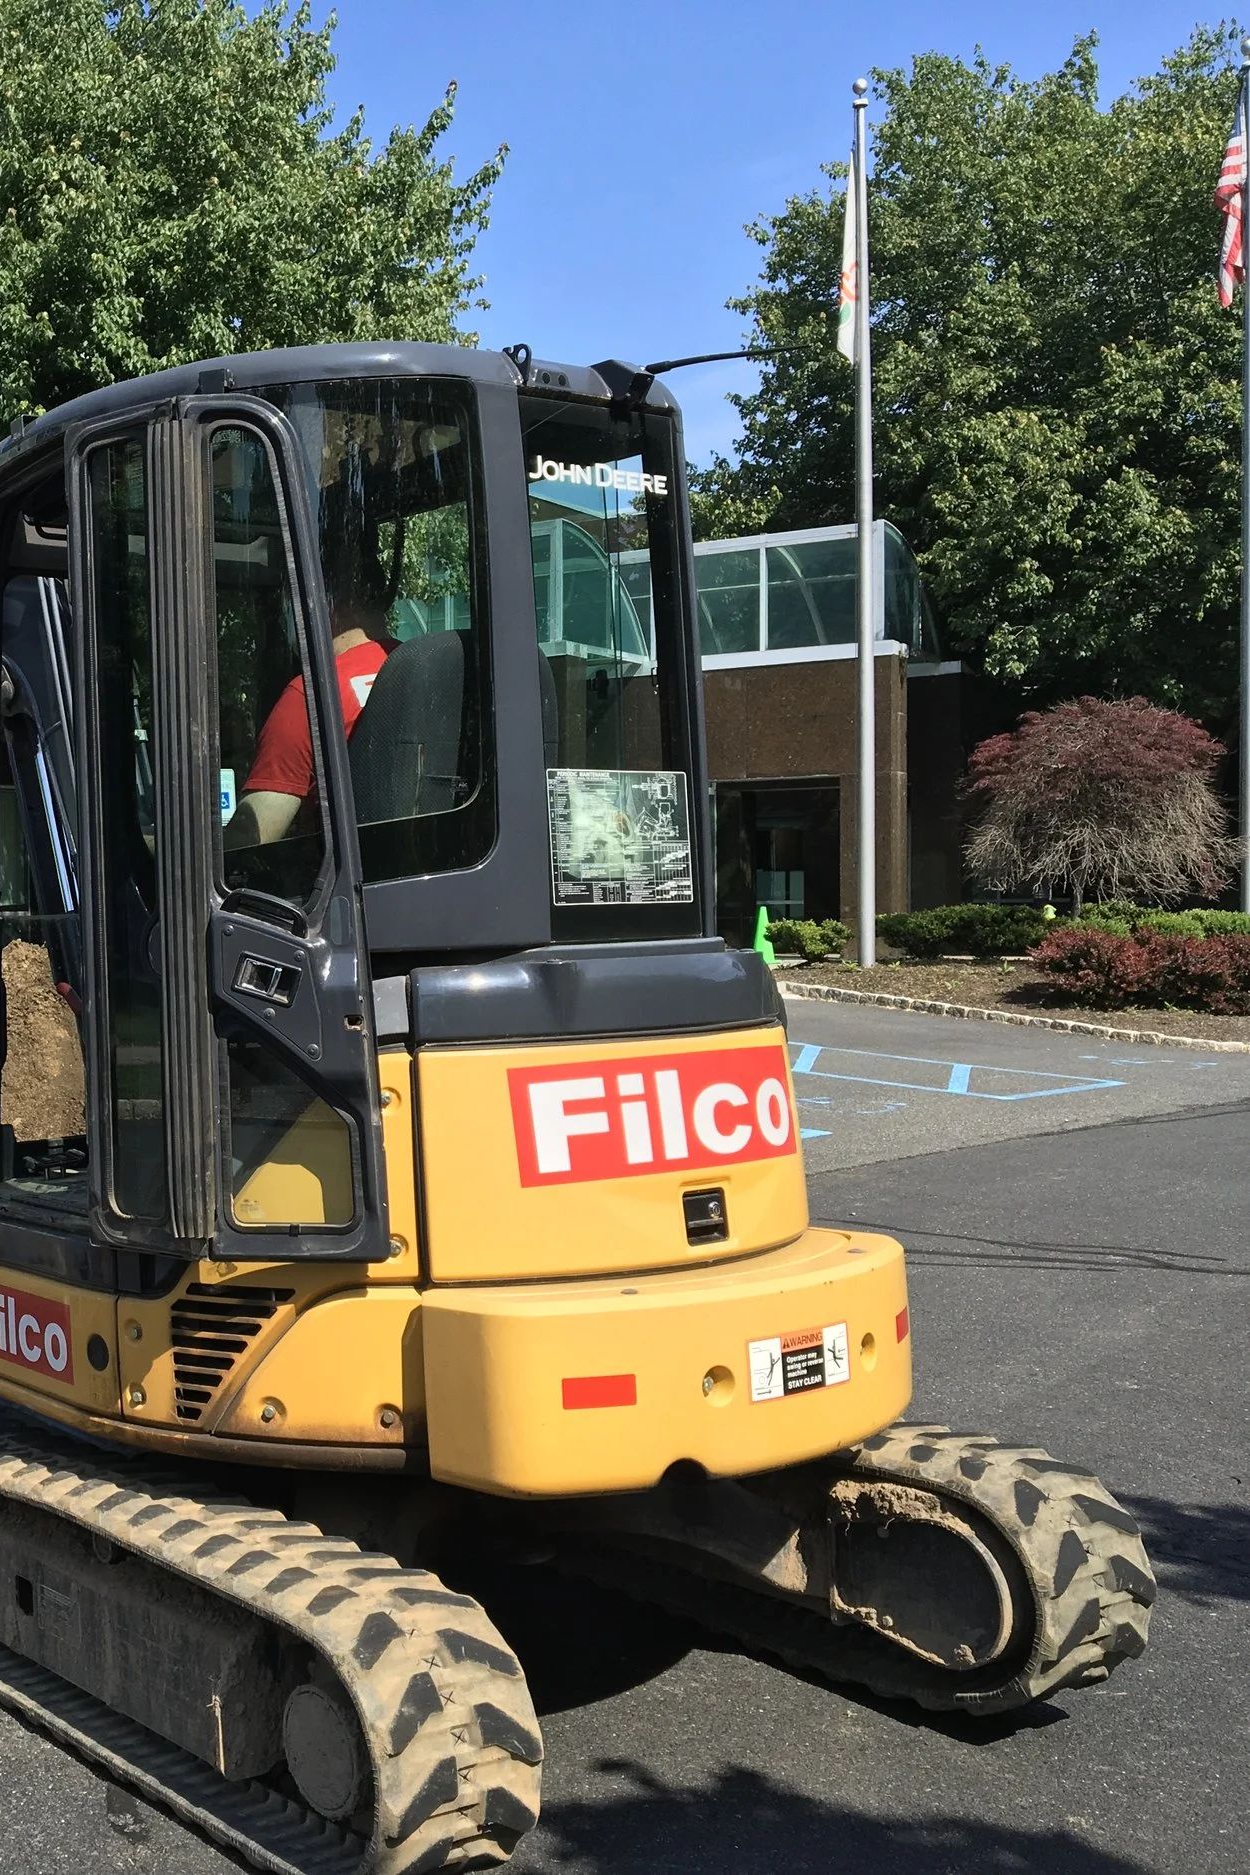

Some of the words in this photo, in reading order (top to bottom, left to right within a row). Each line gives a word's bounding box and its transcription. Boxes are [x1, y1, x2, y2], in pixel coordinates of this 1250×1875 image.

[529, 454, 592, 485] JOHN
[595, 462, 668, 495] DEERE
[527, 1068, 790, 1175] Filco
[789, 1333, 823, 1346] WARNING
[786, 1354, 807, 1364] Operator
[807, 1351, 817, 1360] may
[787, 1363, 802, 1371] swing
[807, 1358, 823, 1366] reverse
[788, 1369, 807, 1378] machine
[788, 1379, 804, 1389] STAY
[803, 1374, 822, 1385] CLEAR
